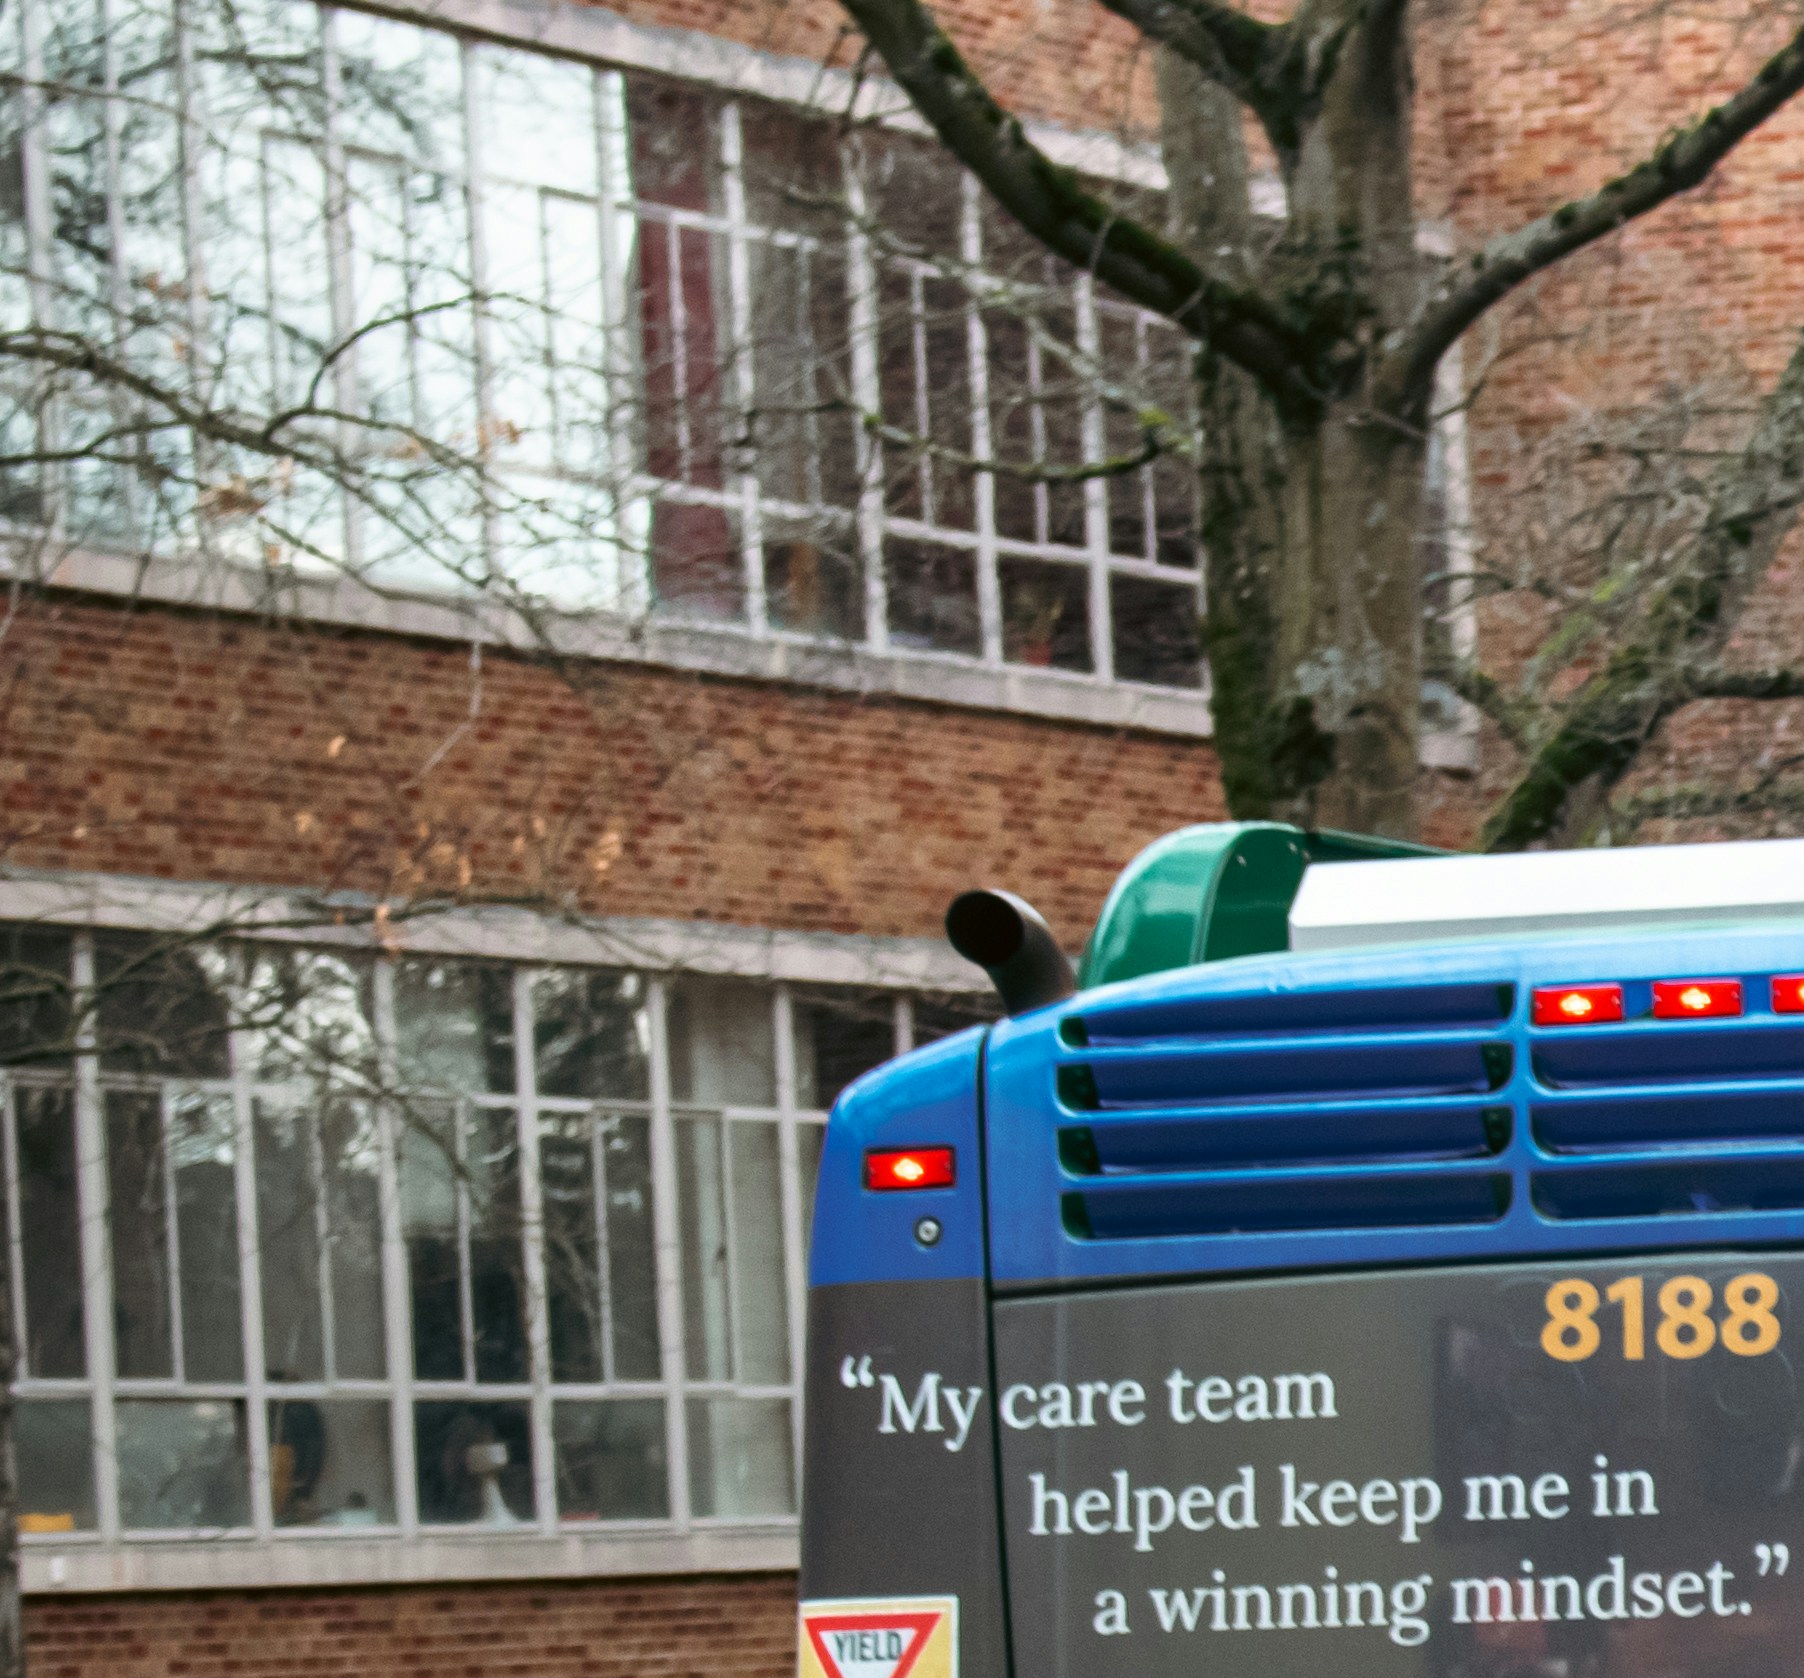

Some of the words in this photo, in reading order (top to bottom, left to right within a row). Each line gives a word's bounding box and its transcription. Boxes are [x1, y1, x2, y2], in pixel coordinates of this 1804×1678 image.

[1540, 1272, 1781, 1362] 8188
[1000, 1381, 1146, 1430] care
[1165, 1368, 1339, 1424] team
[1028, 1465, 1259, 1552] helped
[1278, 1463, 1442, 1543] keep
[1463, 1473, 1571, 1521] me
[1592, 1454, 1660, 1518] in
[833, 1631, 902, 1662] YIELD
[1093, 1588, 1131, 1635] a
[1150, 1569, 1433, 1647] winning
